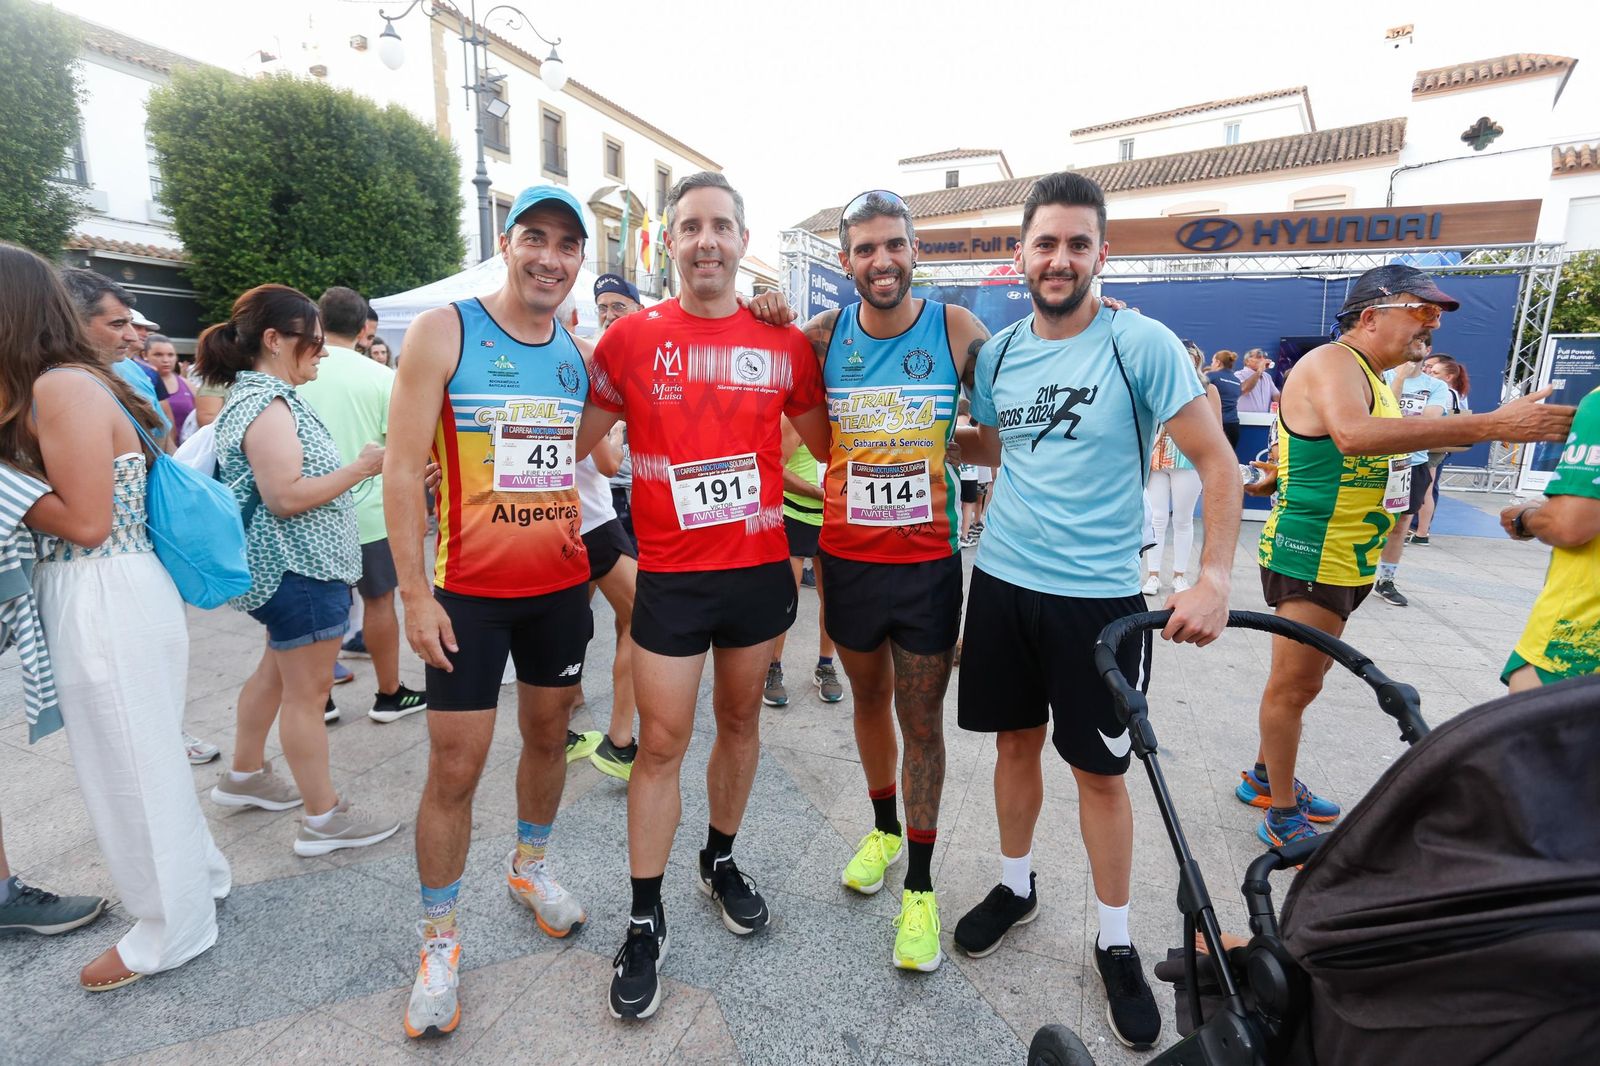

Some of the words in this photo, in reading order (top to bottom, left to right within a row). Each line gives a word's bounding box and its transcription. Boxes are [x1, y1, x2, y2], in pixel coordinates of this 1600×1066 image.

[1253, 212, 1441, 245] HYUNDAI
[972, 237, 1001, 253] Full
[811, 273, 821, 287] Full
[811, 291, 821, 305] Full
[652, 383, 682, 394] María
[851, 391, 898, 412] TRAIL
[509, 402, 558, 422] TRAIL
[1025, 403, 1056, 424] 2024
[840, 413, 887, 430] TEAM
[853, 439, 887, 448] Gabarras
[890, 438, 897, 447] &
[899, 438, 934, 448] Servicios
[527, 445, 558, 469] 43
[512, 476, 548, 485] AVATEL
[694, 476, 742, 505] 191
[865, 480, 913, 504] 114
[491, 502, 579, 527] Algeciras
[710, 502, 733, 510] VICTOR
[692, 509, 728, 522] AVATEL
